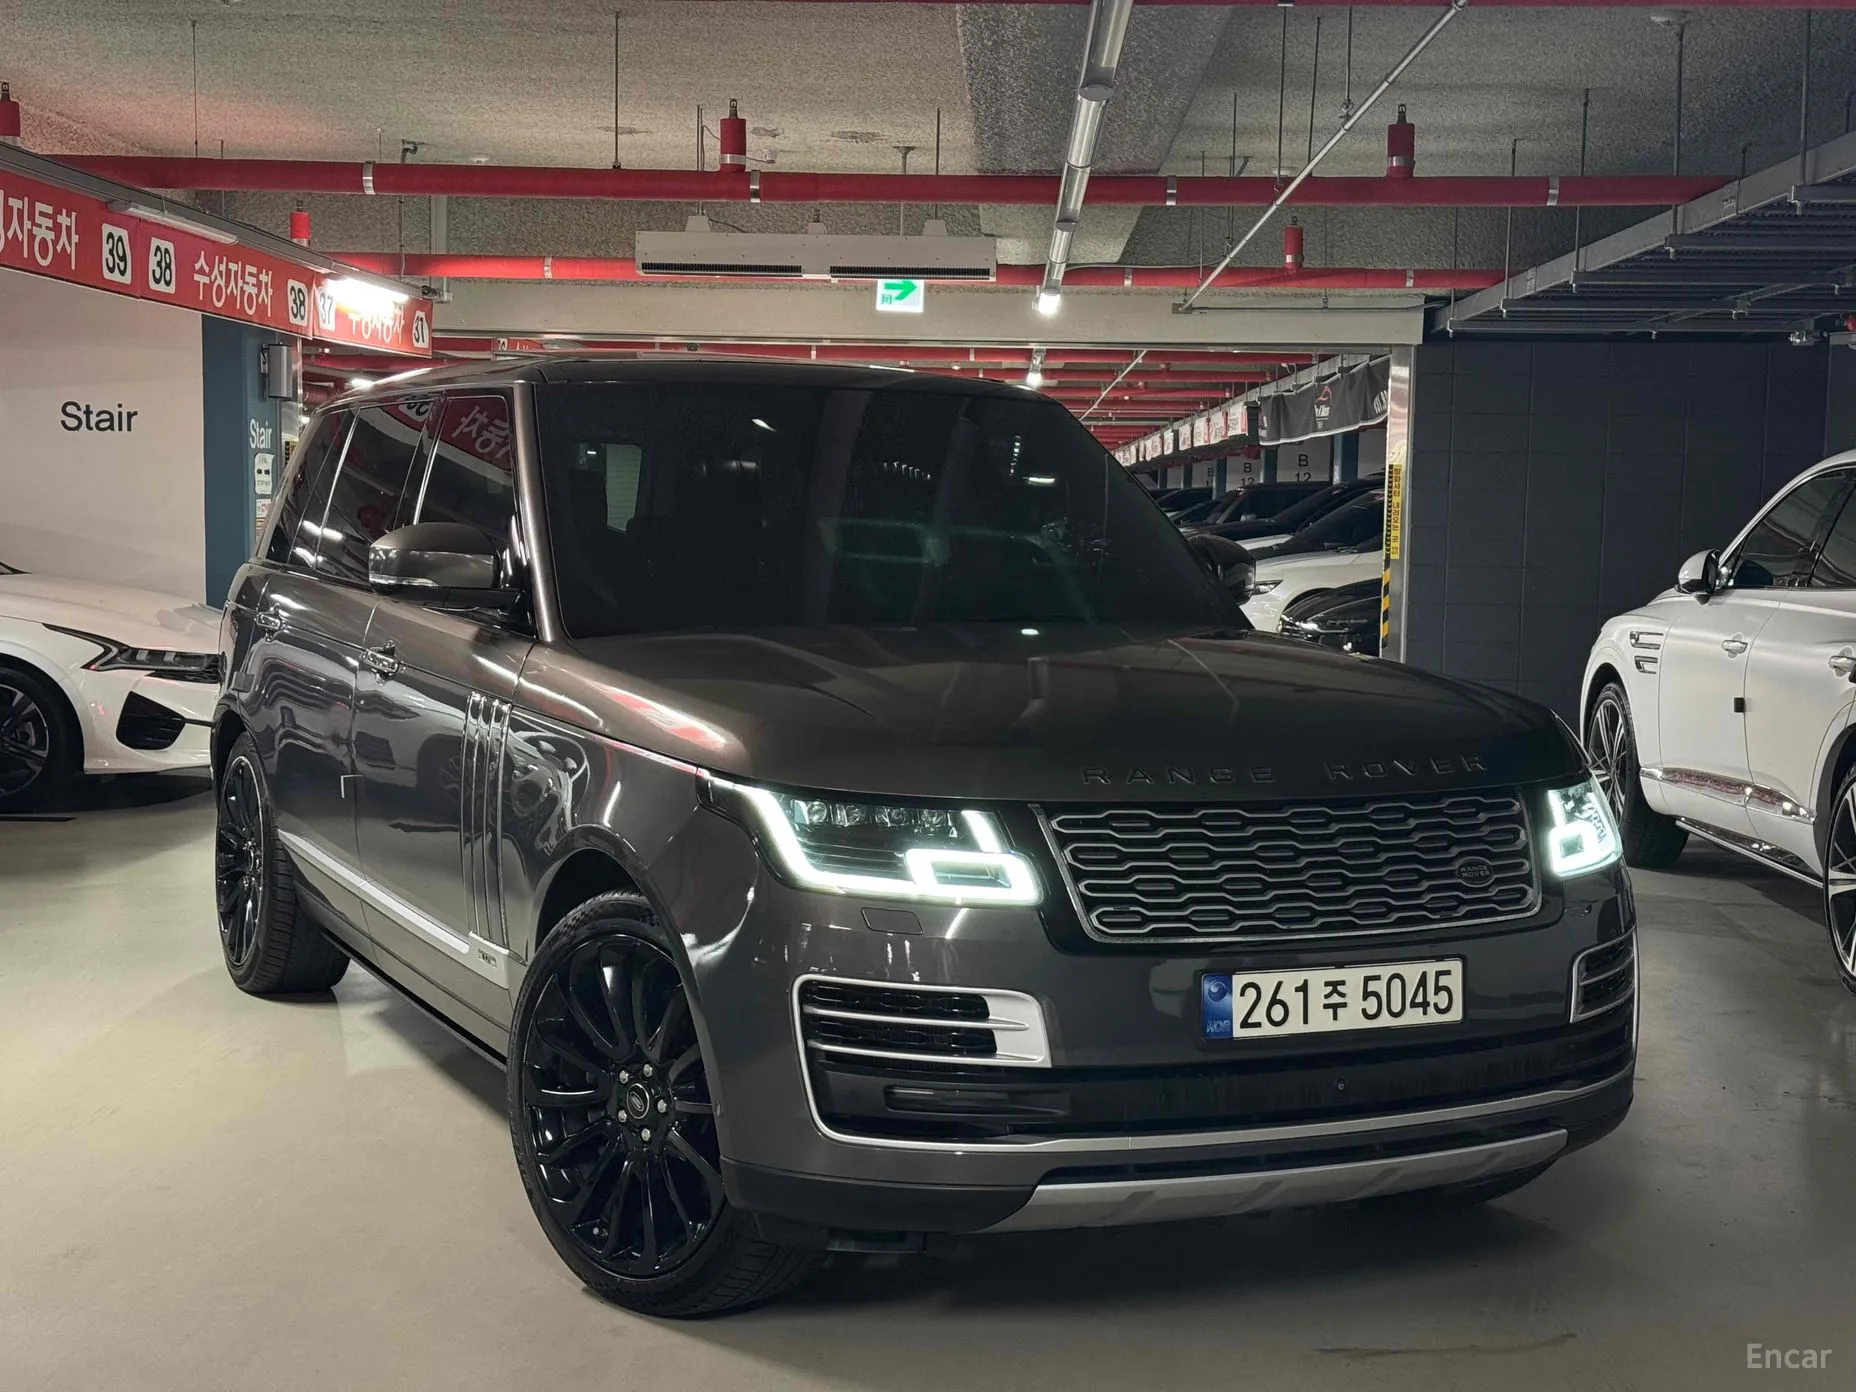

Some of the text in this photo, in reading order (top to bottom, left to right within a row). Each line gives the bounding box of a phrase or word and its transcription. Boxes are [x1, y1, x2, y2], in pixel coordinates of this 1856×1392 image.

[0, 189, 127, 277] 자동차 39
[152, 244, 306, 321] 38 수성자동차 38
[319, 292, 334, 325] 37
[60, 401, 138, 431] Stair
[249, 419, 272, 449] Stair
[1243, 462, 1253, 473] B
[1298, 453, 1309, 467] B
[1081, 754, 1488, 786] RANGE ROVER
